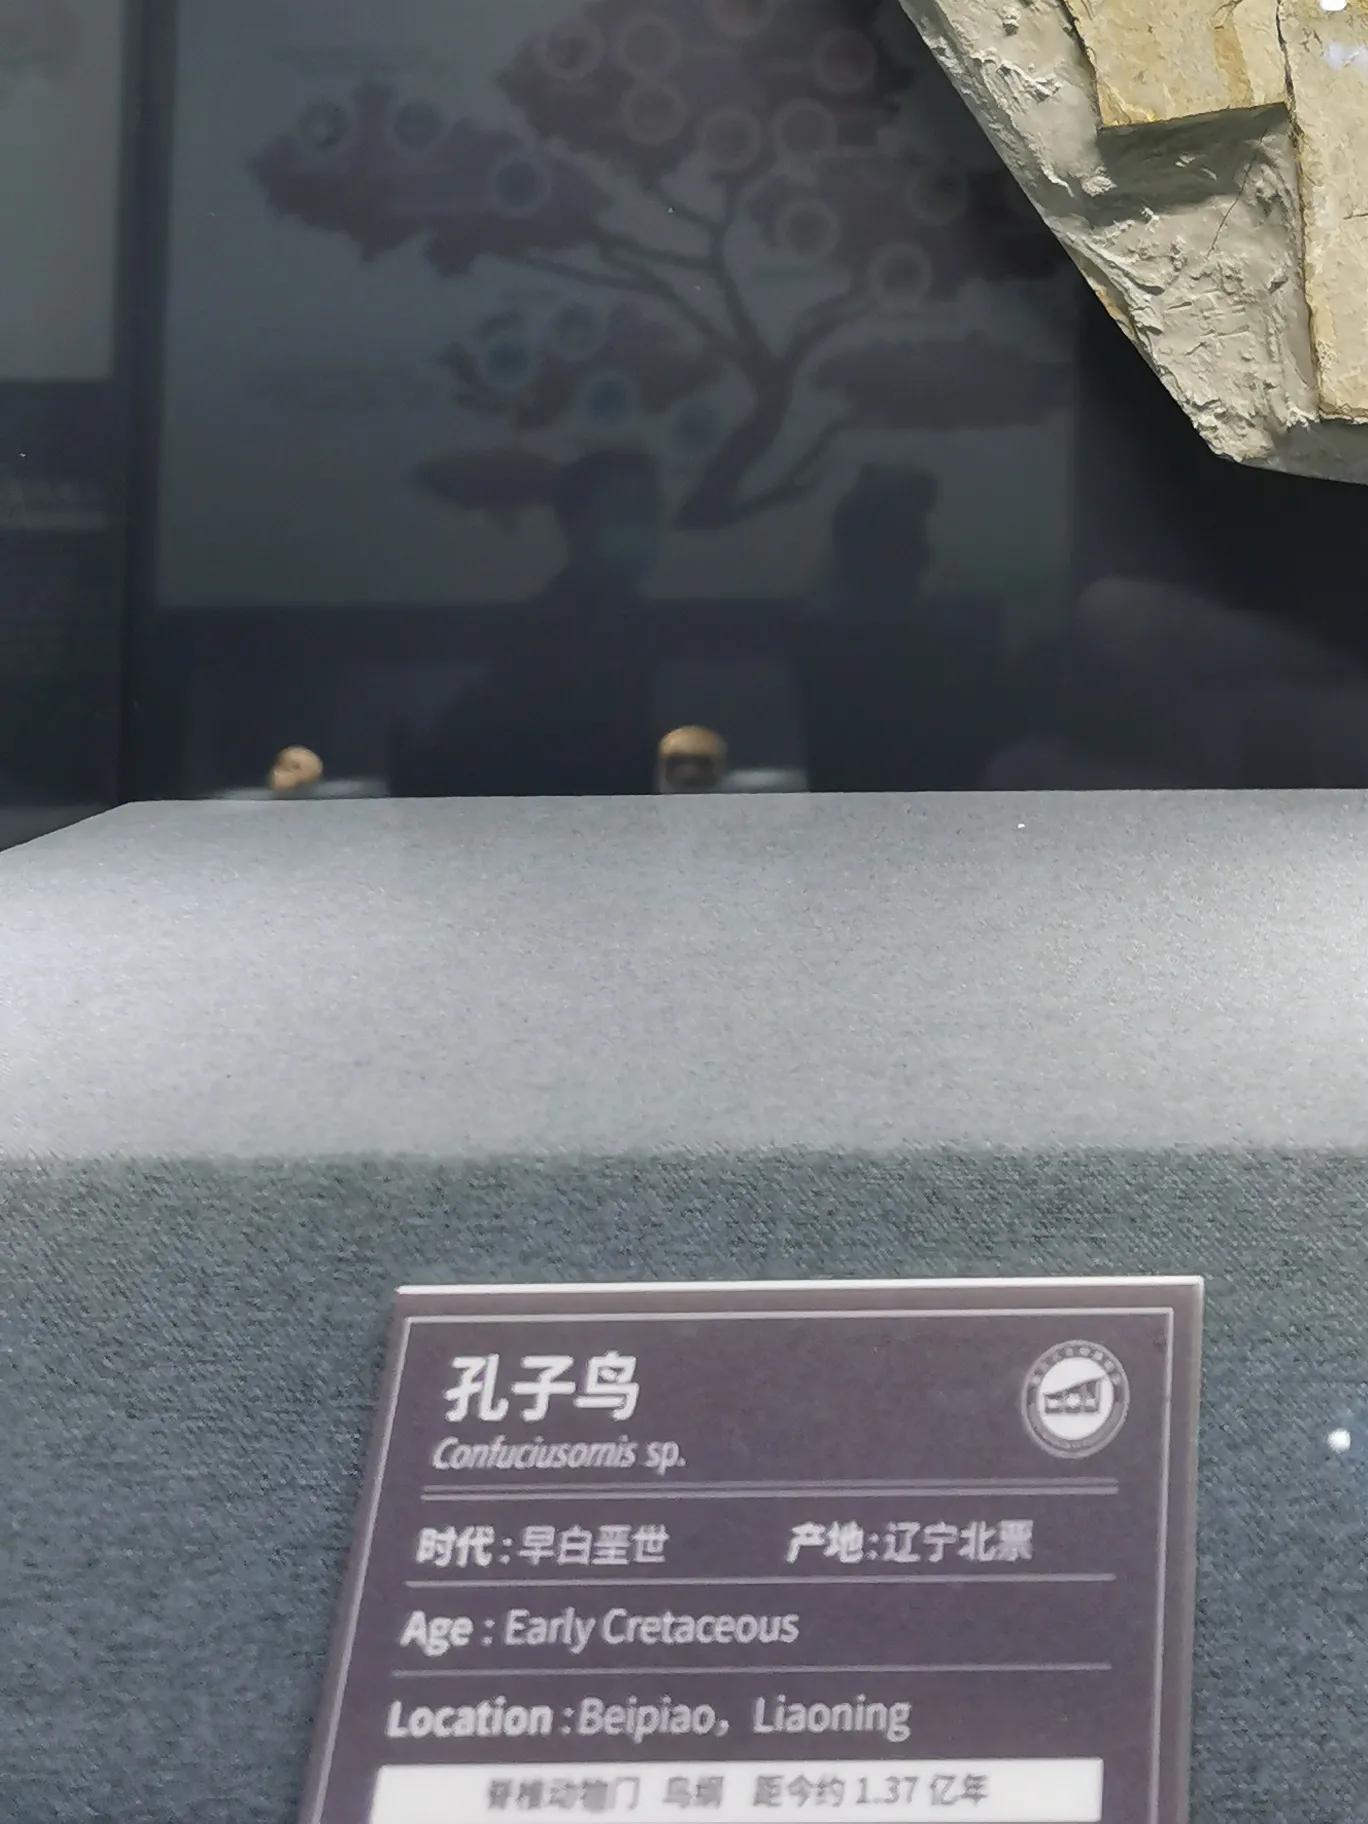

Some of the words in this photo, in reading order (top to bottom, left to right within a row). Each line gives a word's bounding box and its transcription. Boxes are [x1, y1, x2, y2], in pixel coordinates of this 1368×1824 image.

[443, 1351, 639, 1421] 孔子鸟
[645, 1441, 686, 1476] sp.
[505, 1607, 596, 1653] Early
[602, 1609, 800, 1644] Cretaceous
[753, 1694, 911, 1742] Liaoning
